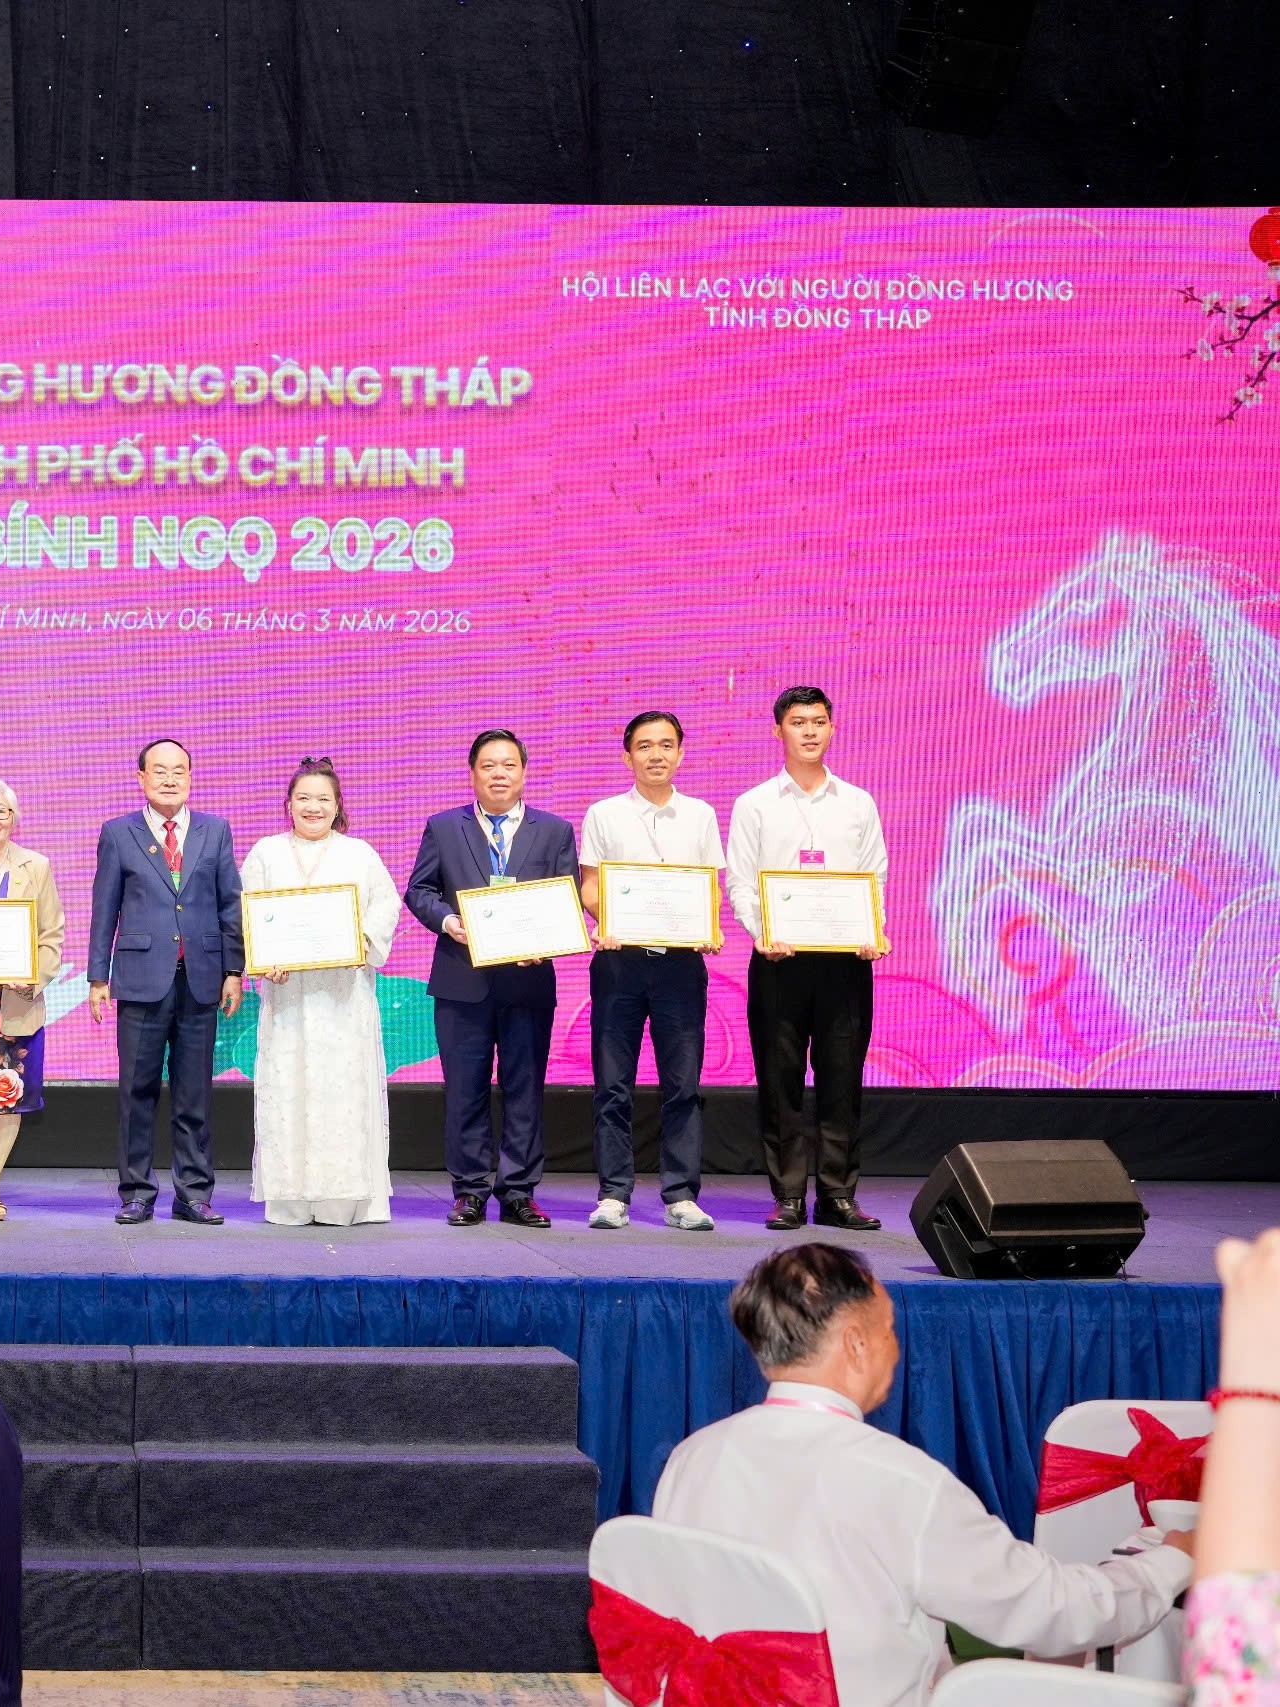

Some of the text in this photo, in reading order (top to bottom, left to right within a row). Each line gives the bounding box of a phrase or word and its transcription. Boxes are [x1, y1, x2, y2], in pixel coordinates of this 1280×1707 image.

[562, 271, 1075, 303] HỘI LIÊN LẠC VỚI NGƯỜI ĐỒNG HƯƠNG
[704, 301, 932, 330] TỈNH ĐỒNG THÁP
[33, 363, 225, 405] HƯƠNG
[232, 354, 383, 406] ĐỒNG
[391, 356, 534, 407] THÁP
[37, 433, 145, 484] PHỐ
[154, 433, 230, 485] HỒ
[239, 435, 329, 487] CHÍ
[334, 447, 466, 488] MINH
[132, 515, 278, 583] NGỌ
[290, 516, 455, 573] 2026
[177, 608, 213, 632] 06
[314, 610, 332, 632] 3
[404, 610, 472, 633] 2026
